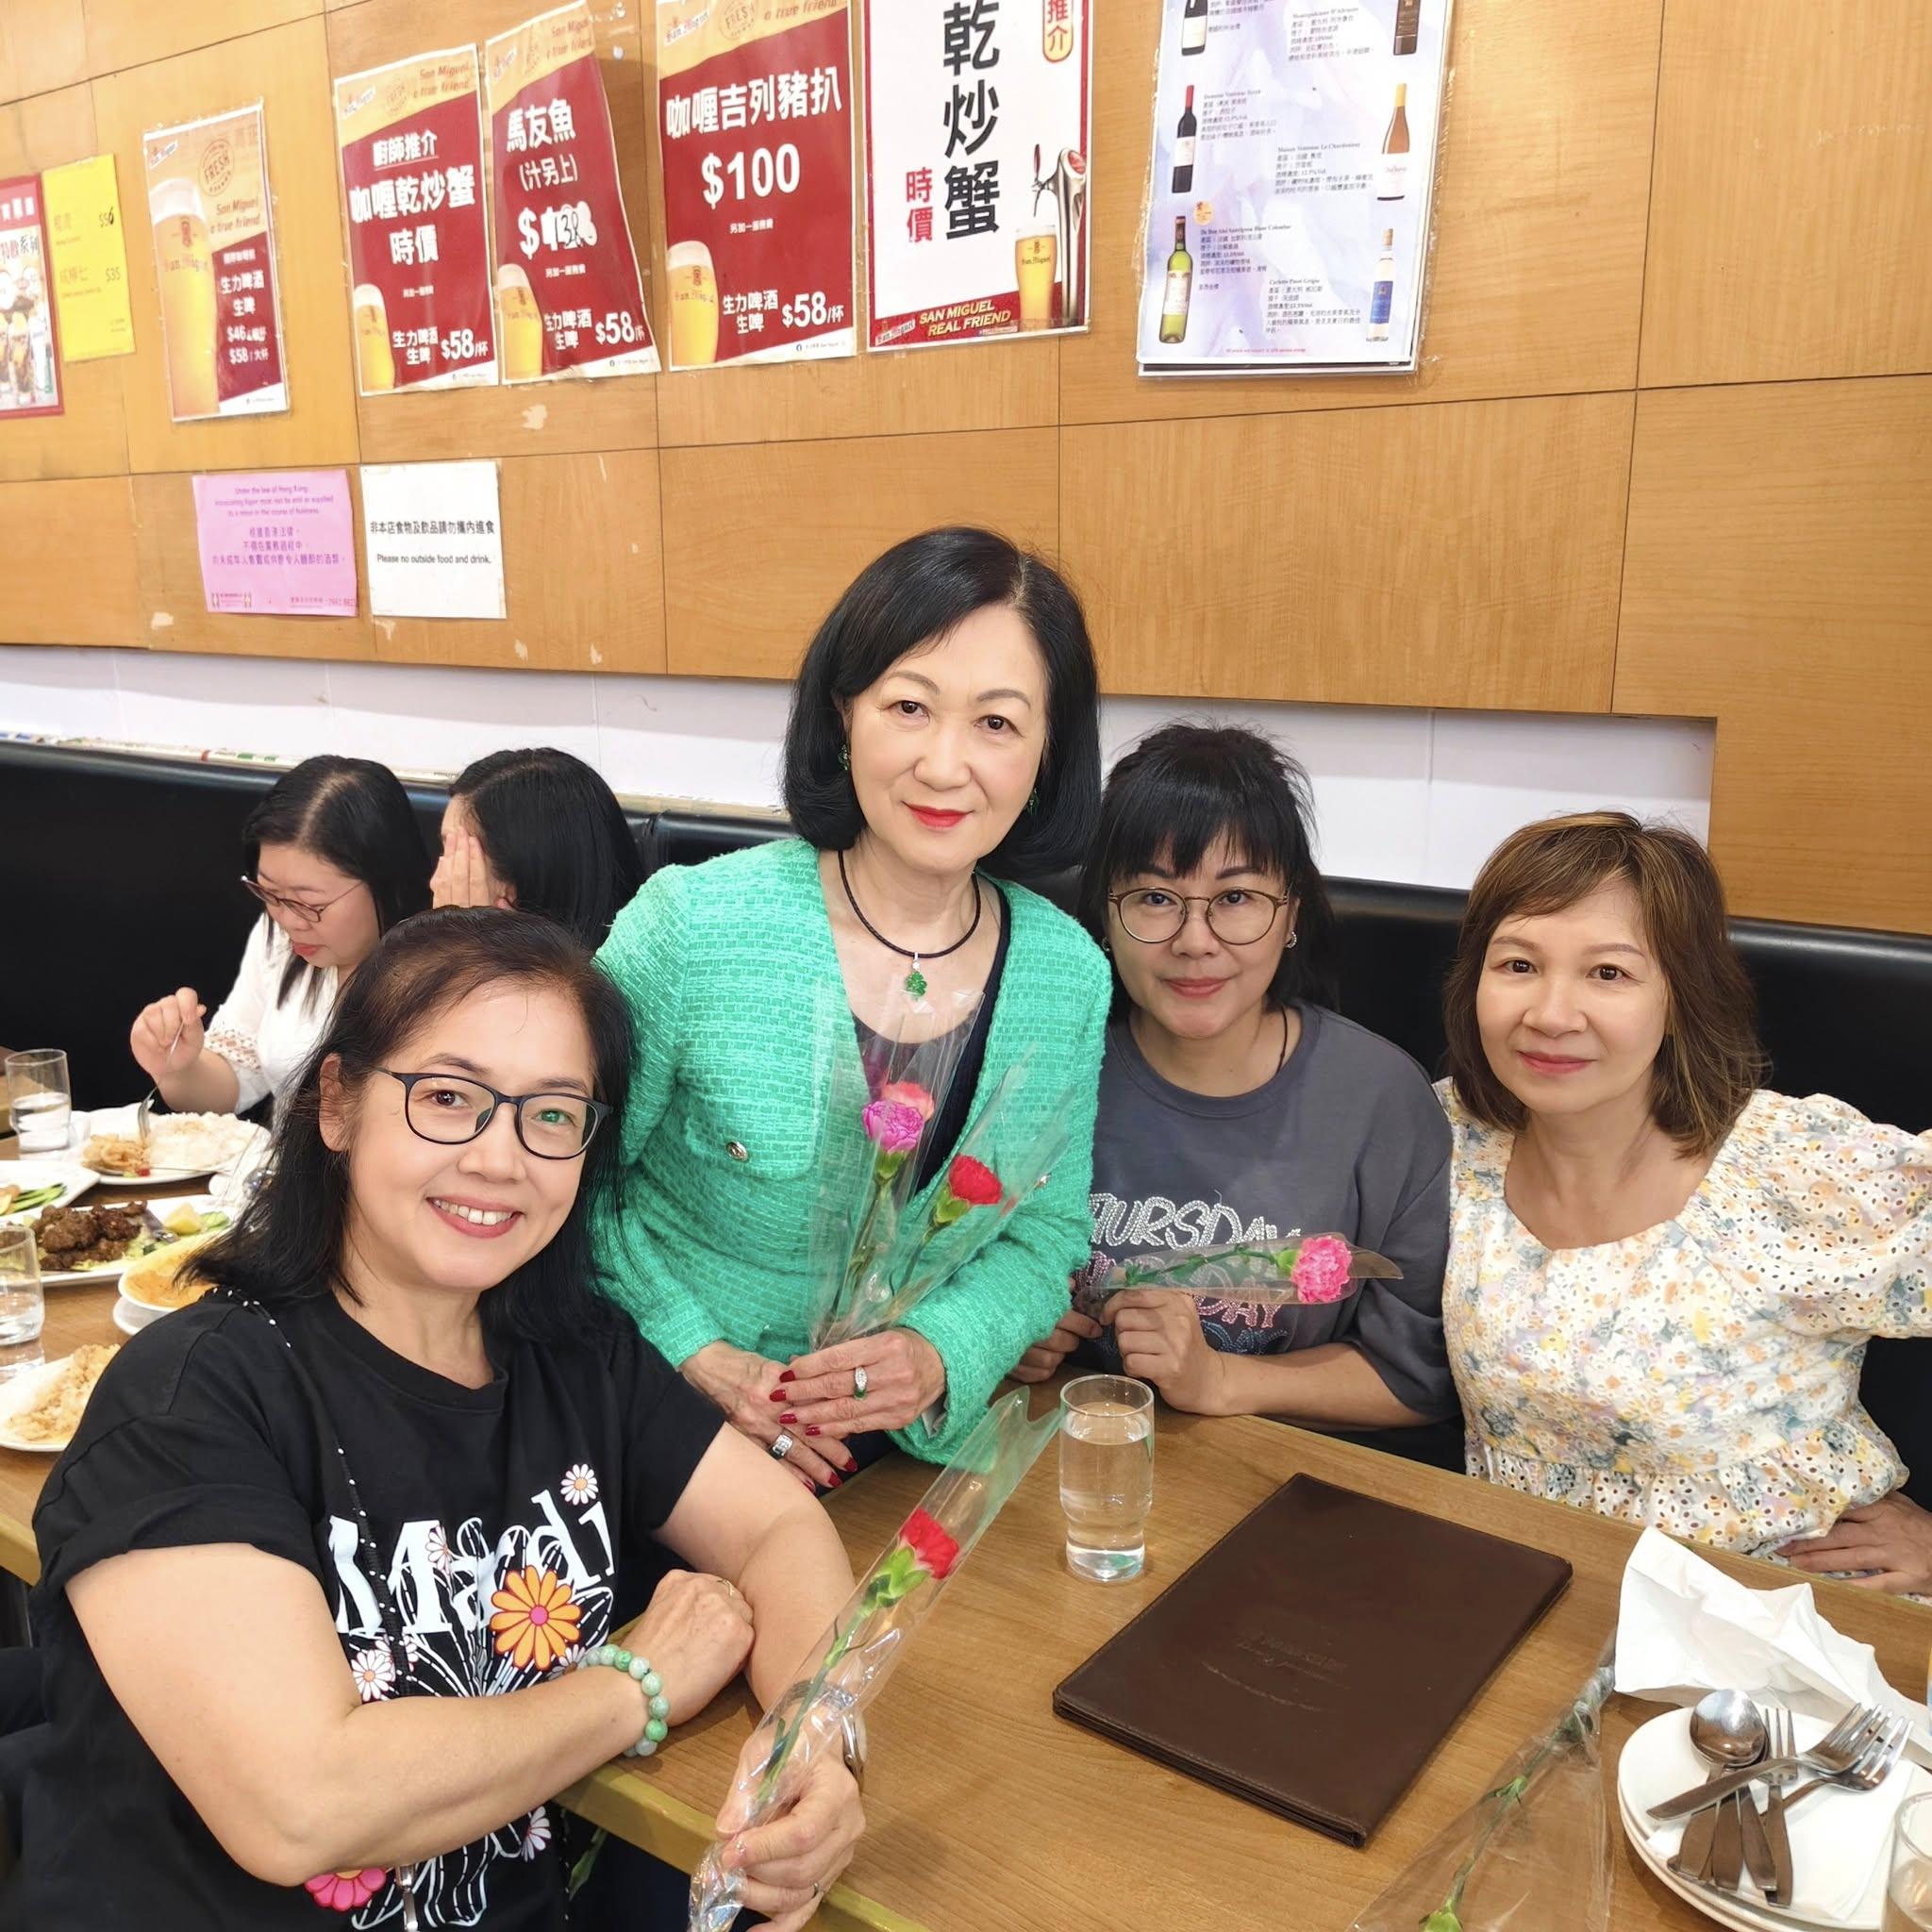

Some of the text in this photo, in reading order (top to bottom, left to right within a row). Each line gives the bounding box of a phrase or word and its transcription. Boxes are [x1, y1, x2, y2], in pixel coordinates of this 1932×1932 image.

[1047, 0, 1069, 52] 推介
[507, 98, 576, 153] 馬友魚
[665, 66, 842, 140] 咖喱吉列豬扒
[943, 0, 1000, 240] 乾炒蟹
[349, 164, 476, 224] 咖喱乾炒蟹
[700, 143, 801, 210] $100
[906, 167, 933, 243] 時價
[390, 225, 439, 266] 時價
[723, 289, 778, 315] 生力啤酒
[736, 313, 765, 334] 生啤
[920, 300, 995, 325] SAN MIGUEL
[928, 322, 961, 337] REAL
[963, 310, 1011, 330] FRIEND
[392, 326, 439, 348] 生力啤酒
[377, 553, 399, 563] Please
[411, 555, 435, 563] outside
[437, 555, 453, 563] food
[456, 555, 468, 563] and
